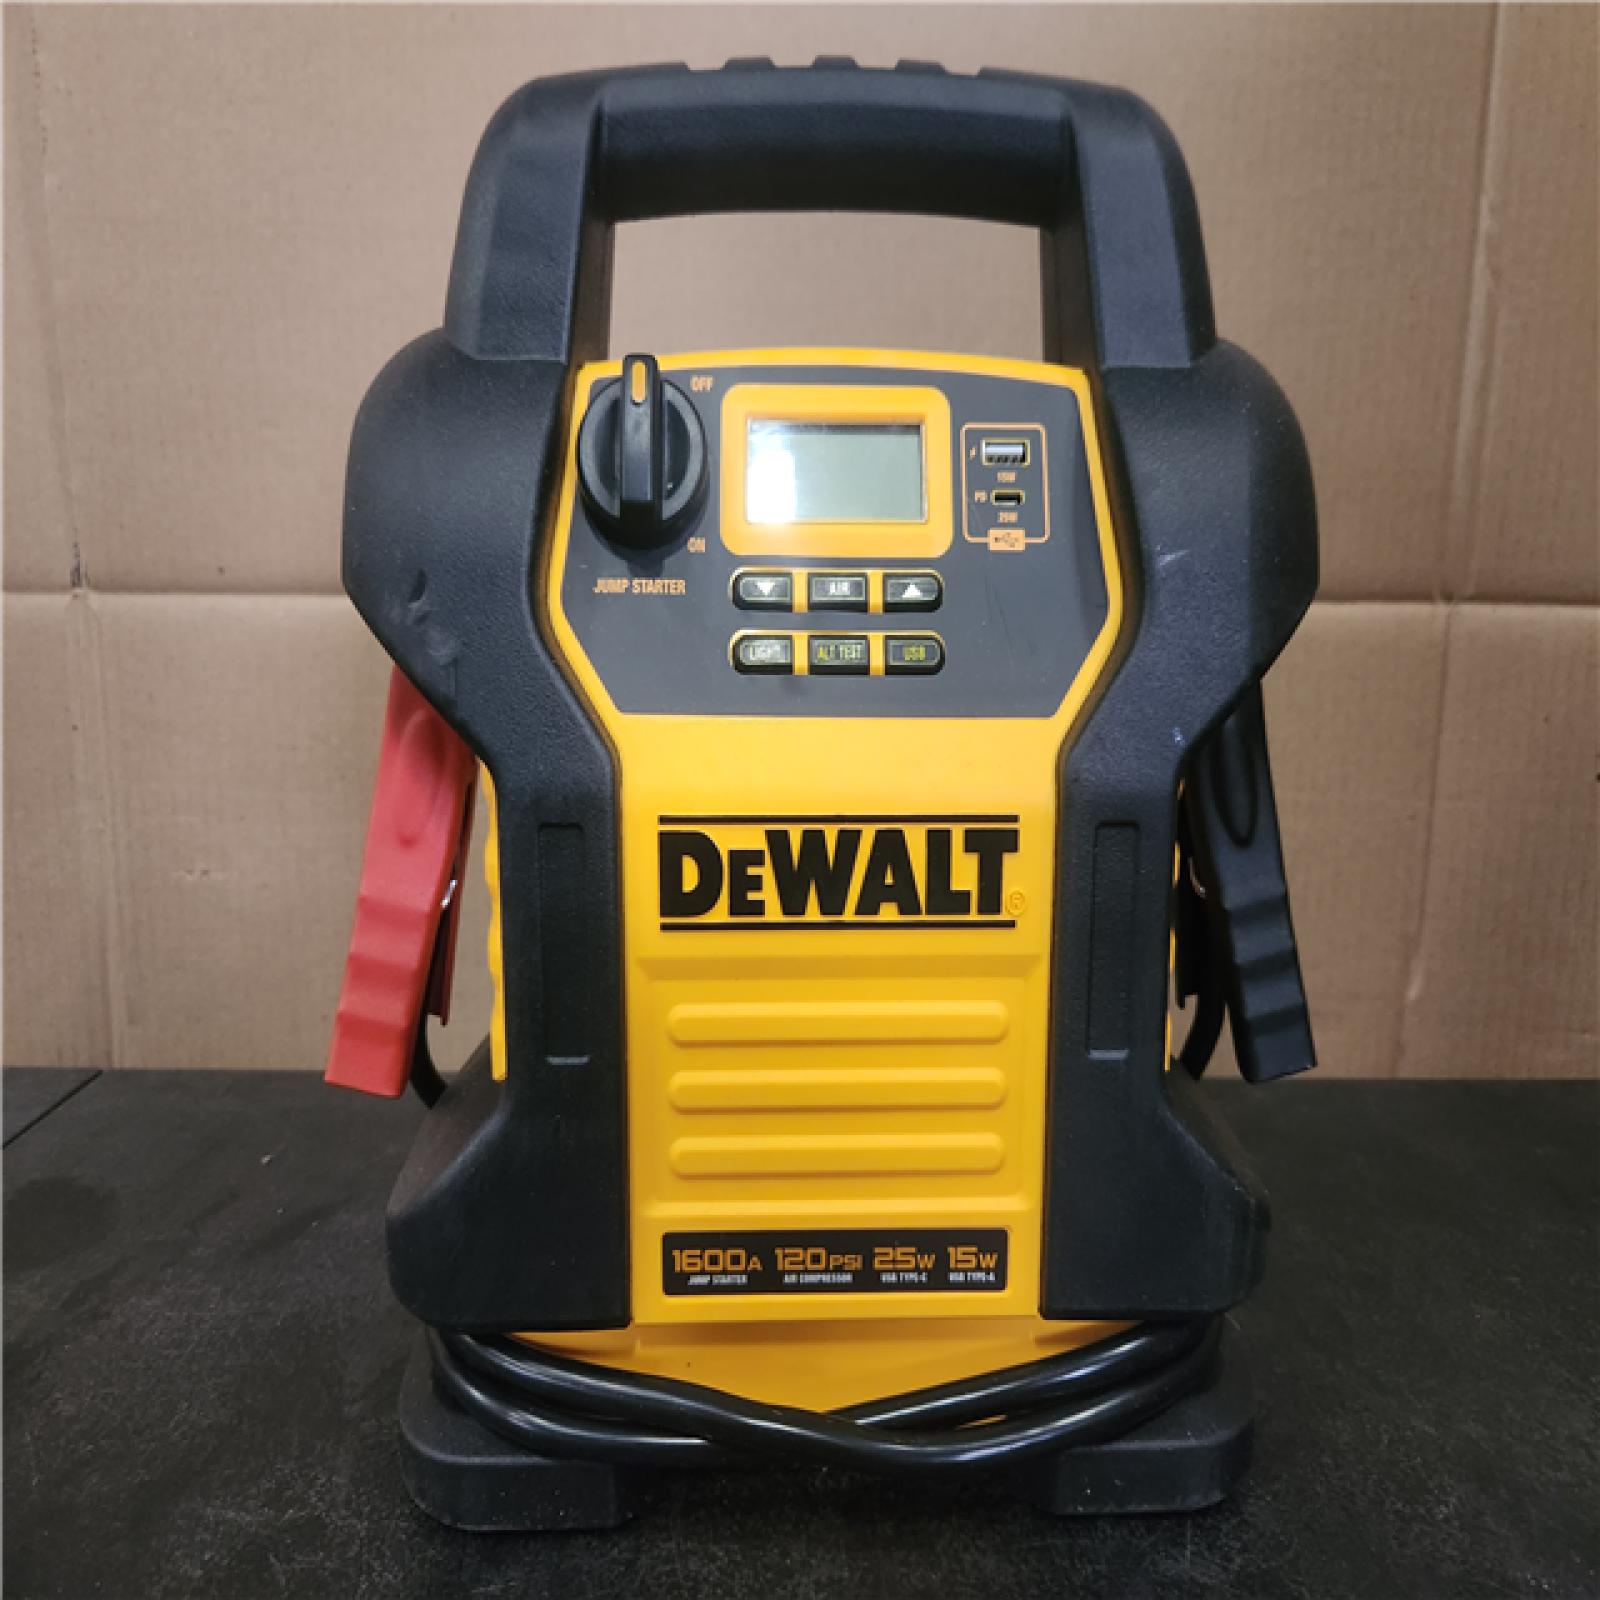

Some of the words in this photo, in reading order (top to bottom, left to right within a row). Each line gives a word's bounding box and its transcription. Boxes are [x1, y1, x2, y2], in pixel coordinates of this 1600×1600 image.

[691, 375, 713, 391] OFF
[593, 578, 629, 594] JUMP
[632, 578, 686, 595] STARTER
